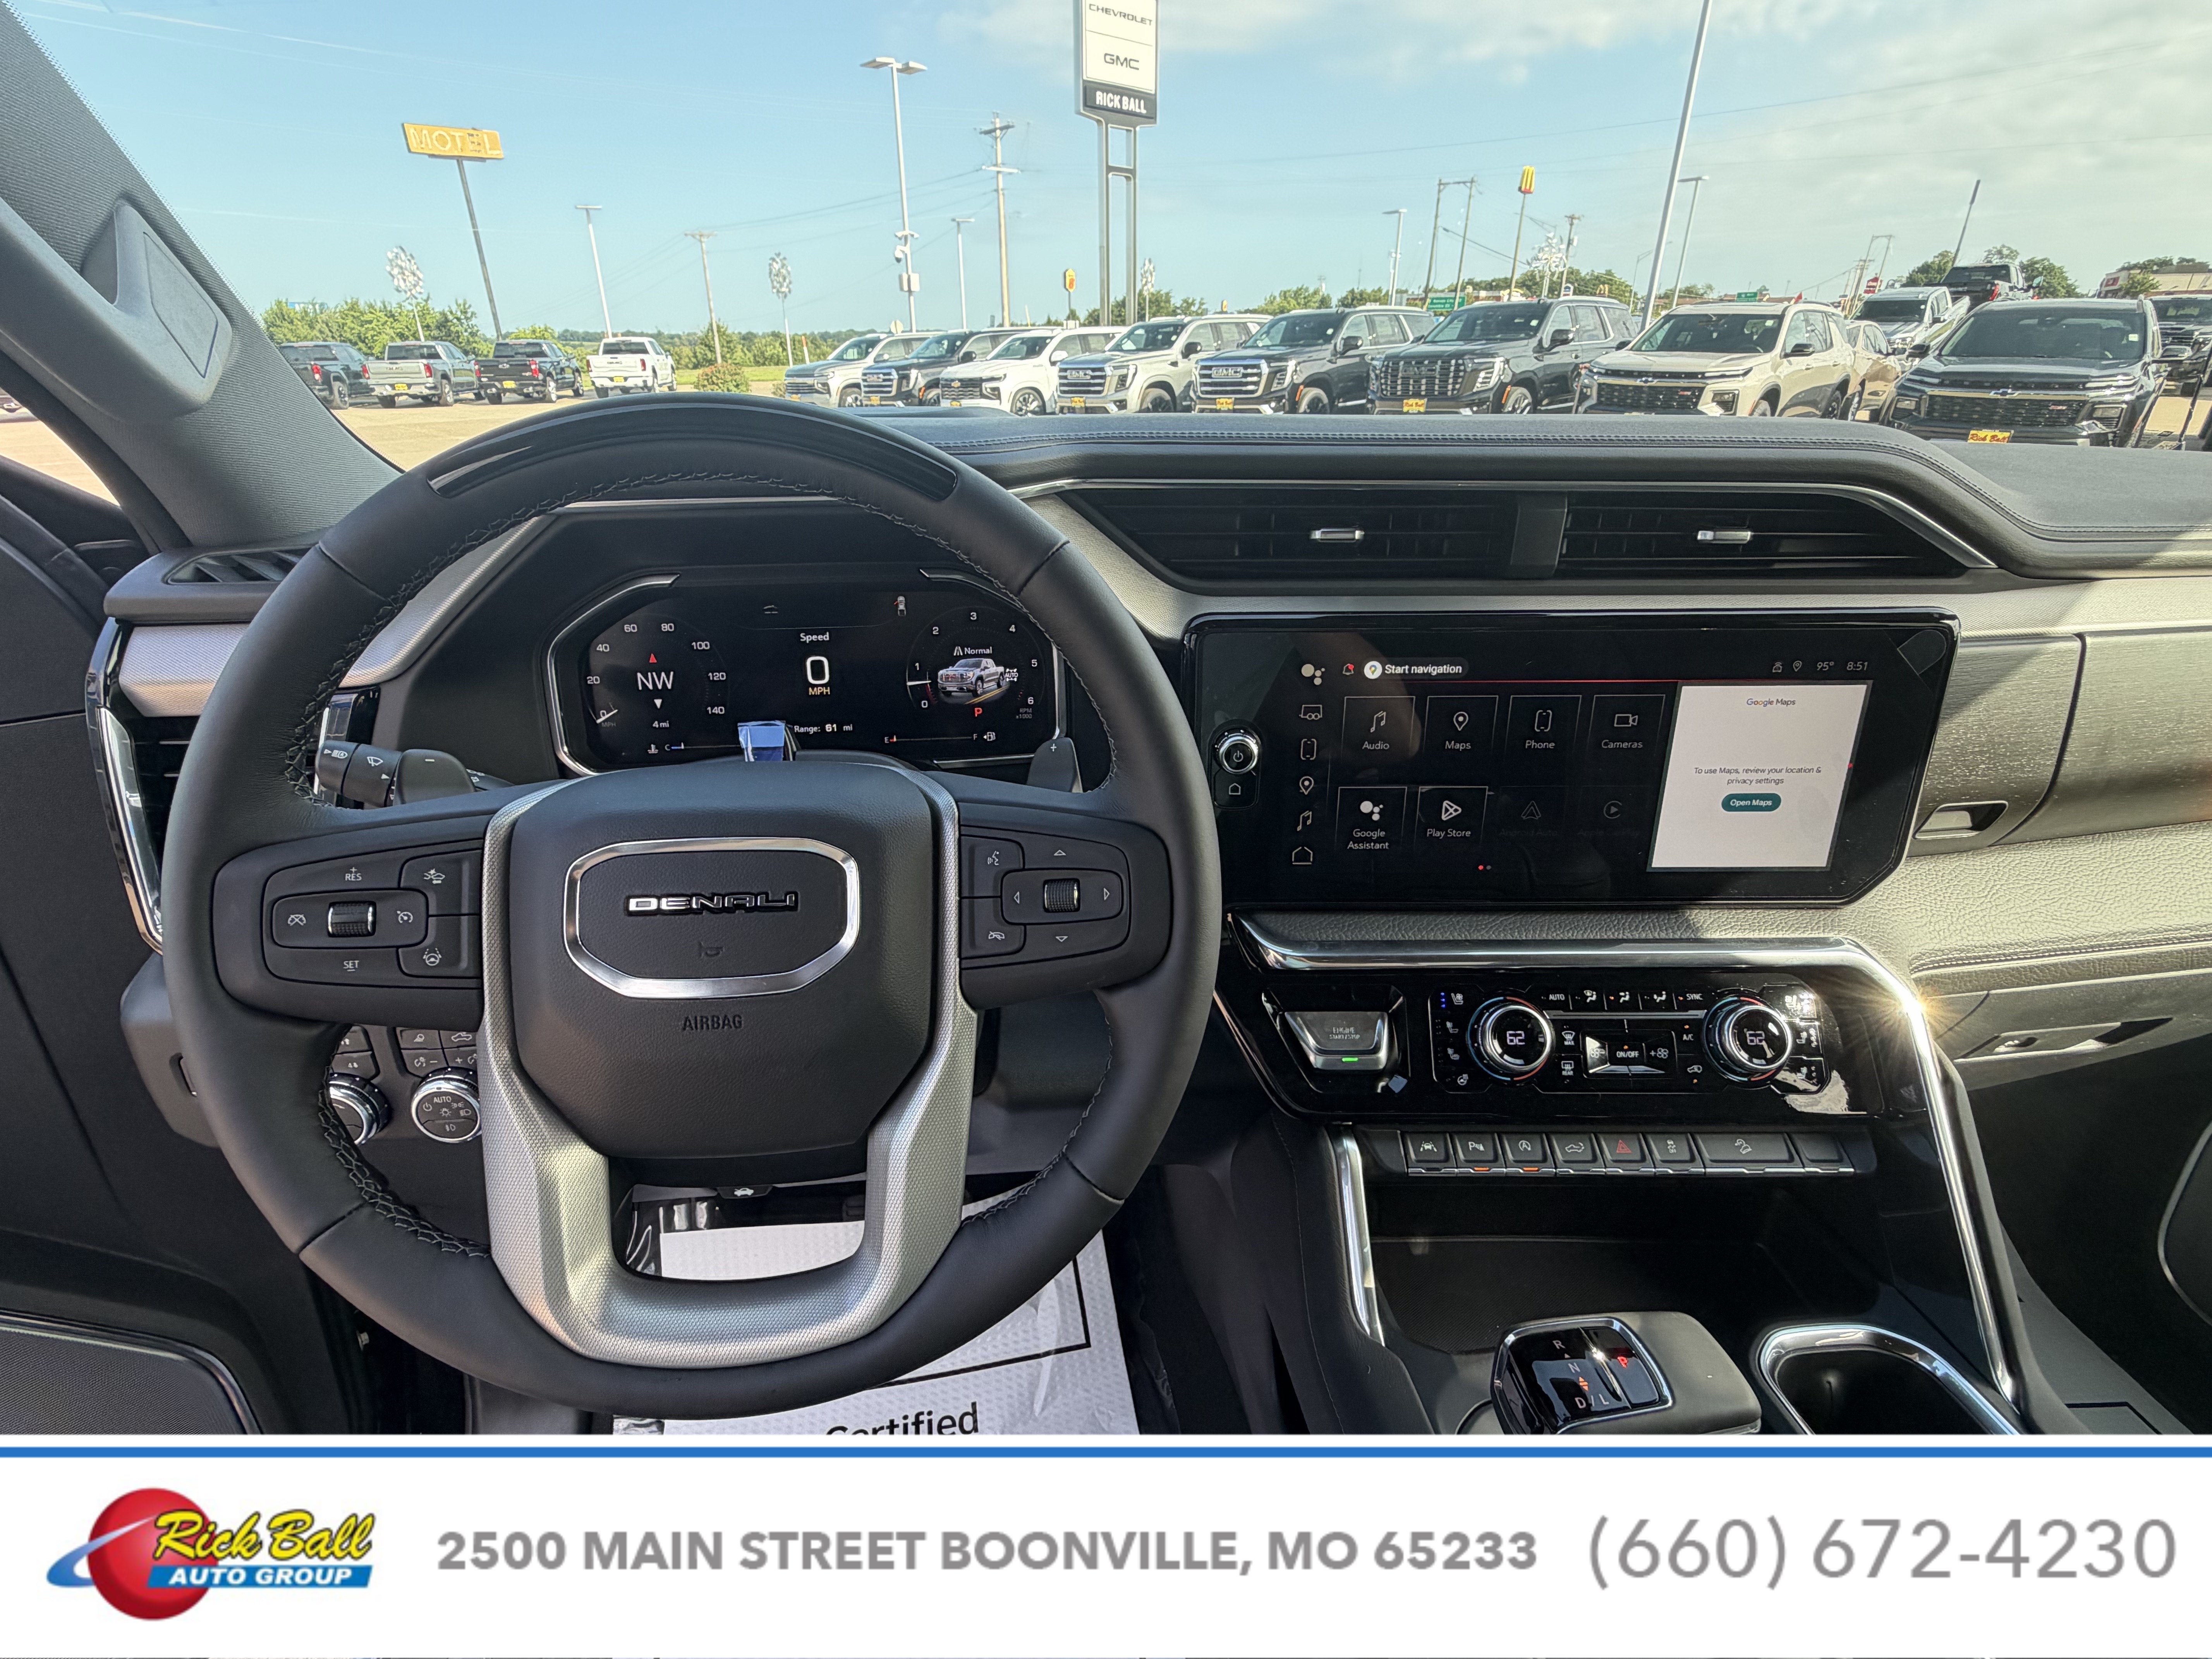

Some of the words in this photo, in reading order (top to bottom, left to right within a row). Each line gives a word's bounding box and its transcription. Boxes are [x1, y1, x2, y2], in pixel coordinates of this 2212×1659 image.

[1089, 3, 1152, 26] CHEVROLET
[1104, 53, 1139, 70] GMC
[1096, 91, 1121, 109] RICK
[1122, 96, 1146, 113] BALL
[409, 127, 501, 155] MOTEL
[624, 624, 637, 632] 60
[933, 627, 939, 635] 2
[800, 632, 829, 643] Speed
[692, 641, 710, 649] 100
[806, 656, 829, 684] 0
[1385, 664, 1408, 674] Start
[1411, 664, 1462, 675] navigation
[1817, 661, 1834, 671] 95°
[1846, 661, 1868, 671] 8:51
[637, 671, 673, 690] NW
[708, 672, 726, 680] 120
[809, 687, 830, 695] MPH
[1747, 698, 1774, 707] Google
[1776, 699, 1796, 707] Maps
[974, 708, 982, 717] P
[794, 726, 821, 734] Range:
[1362, 741, 1389, 750] Audio
[1445, 741, 1471, 751] Maps
[1525, 740, 1555, 749] Phone
[1602, 740, 1643, 749] Cameras
[1727, 777, 1753, 785] privacy
[1730, 799, 1750, 807] Open
[1353, 829, 1386, 840] Google
[1427, 829, 1445, 838] Play
[1447, 829, 1471, 837] Store
[345, 872, 362, 881] RES
[627, 892, 799, 912] DENALI
[343, 960, 359, 969] SET
[682, 1015, 743, 1031] AIRBAG
[1506, 1031, 1525, 1045] 62
[1746, 1031, 1765, 1045] 62
[1553, 1340, 1565, 1350] R
[1568, 1362, 1580, 1373] N
[826, 1401, 979, 1435] tified
